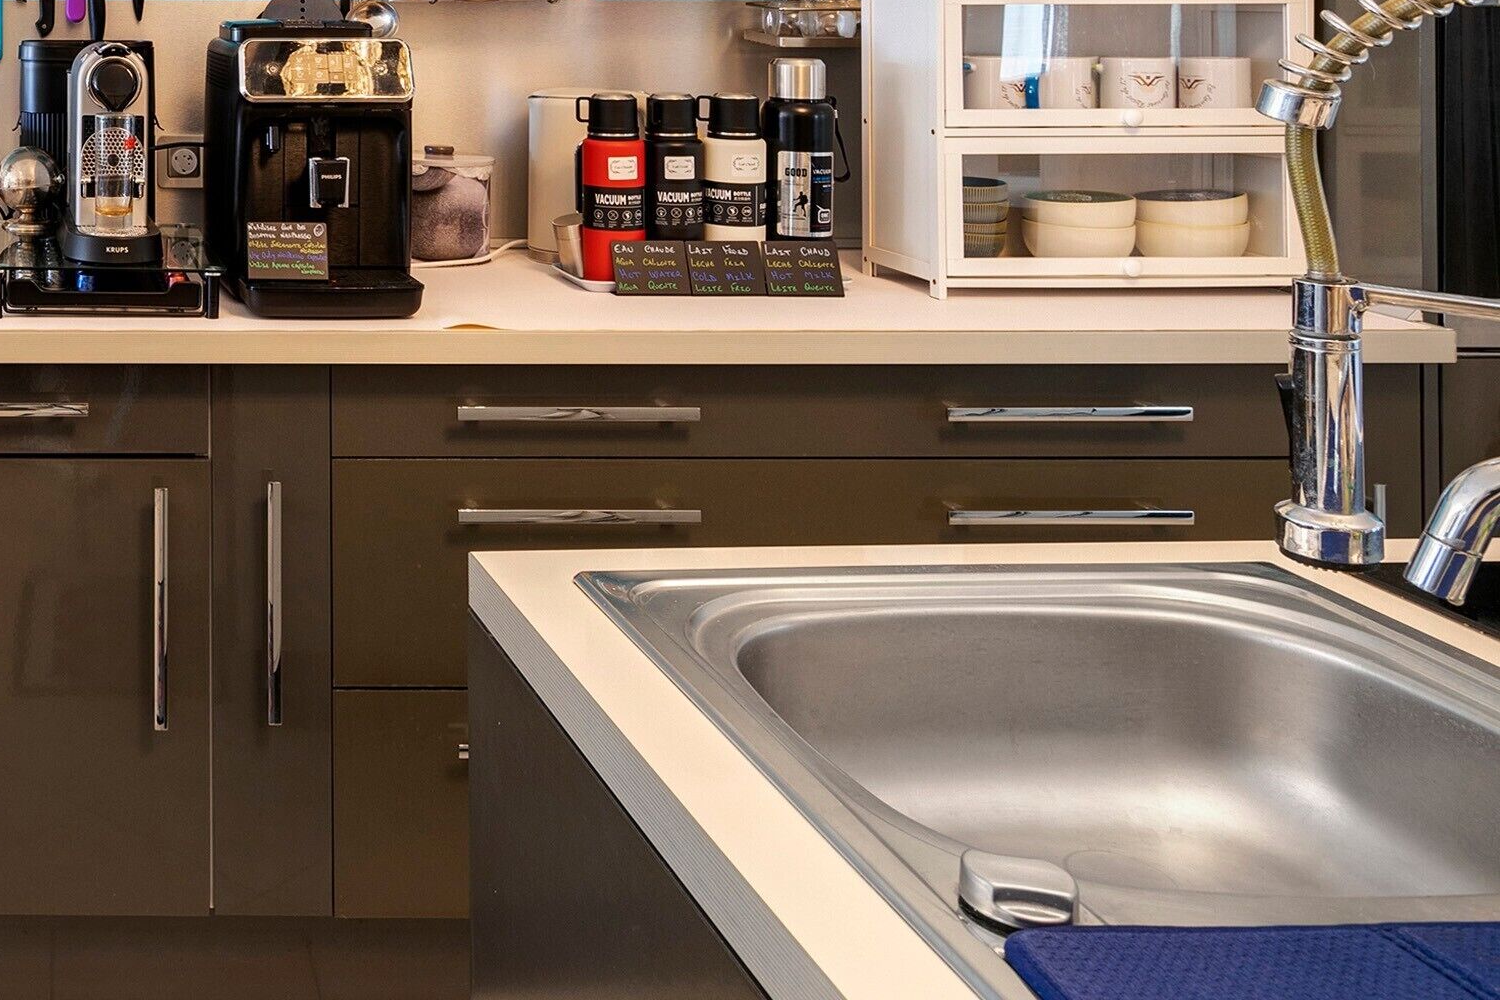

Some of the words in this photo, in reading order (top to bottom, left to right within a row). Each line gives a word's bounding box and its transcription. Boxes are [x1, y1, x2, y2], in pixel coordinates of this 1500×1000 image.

[785, 168, 808, 177] GOOD
[595, 194, 627, 205] VACUUM
[657, 191, 690, 202] VACUUM
[614, 244, 634, 253] EAU
[644, 245, 675, 253] CHAUDE
[688, 244, 713, 254] LAIT
[764, 244, 792, 256] LAIT
[800, 246, 830, 256] CHAUD
[619, 269, 642, 279] HOT
[649, 270, 682, 279] WATER
[692, 272, 717, 281] COLD
[726, 272, 755, 281] MILK
[770, 270, 794, 280] HOT
[804, 272, 834, 280] MILK
